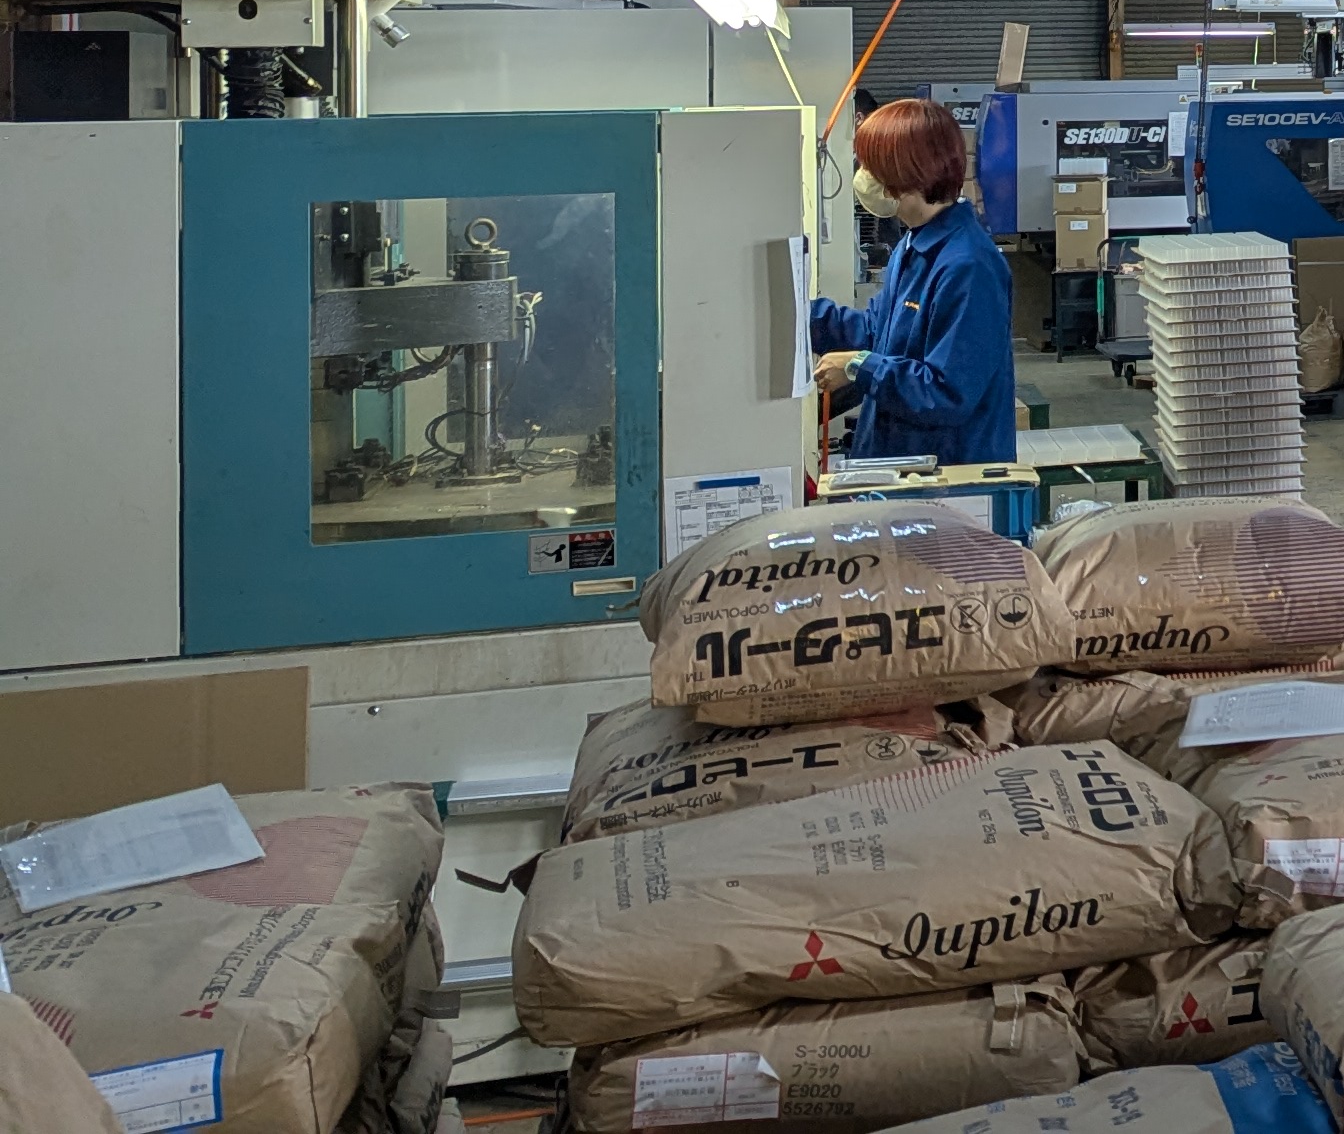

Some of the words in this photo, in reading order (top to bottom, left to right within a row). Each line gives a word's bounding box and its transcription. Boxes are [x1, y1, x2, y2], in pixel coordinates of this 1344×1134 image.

[683, 603, 769, 624] COPOLYMER
[696, 605, 945, 679] ユピタール
[794, 1044, 872, 1061] S-3000U
[786, 1083, 842, 1100] E9020
